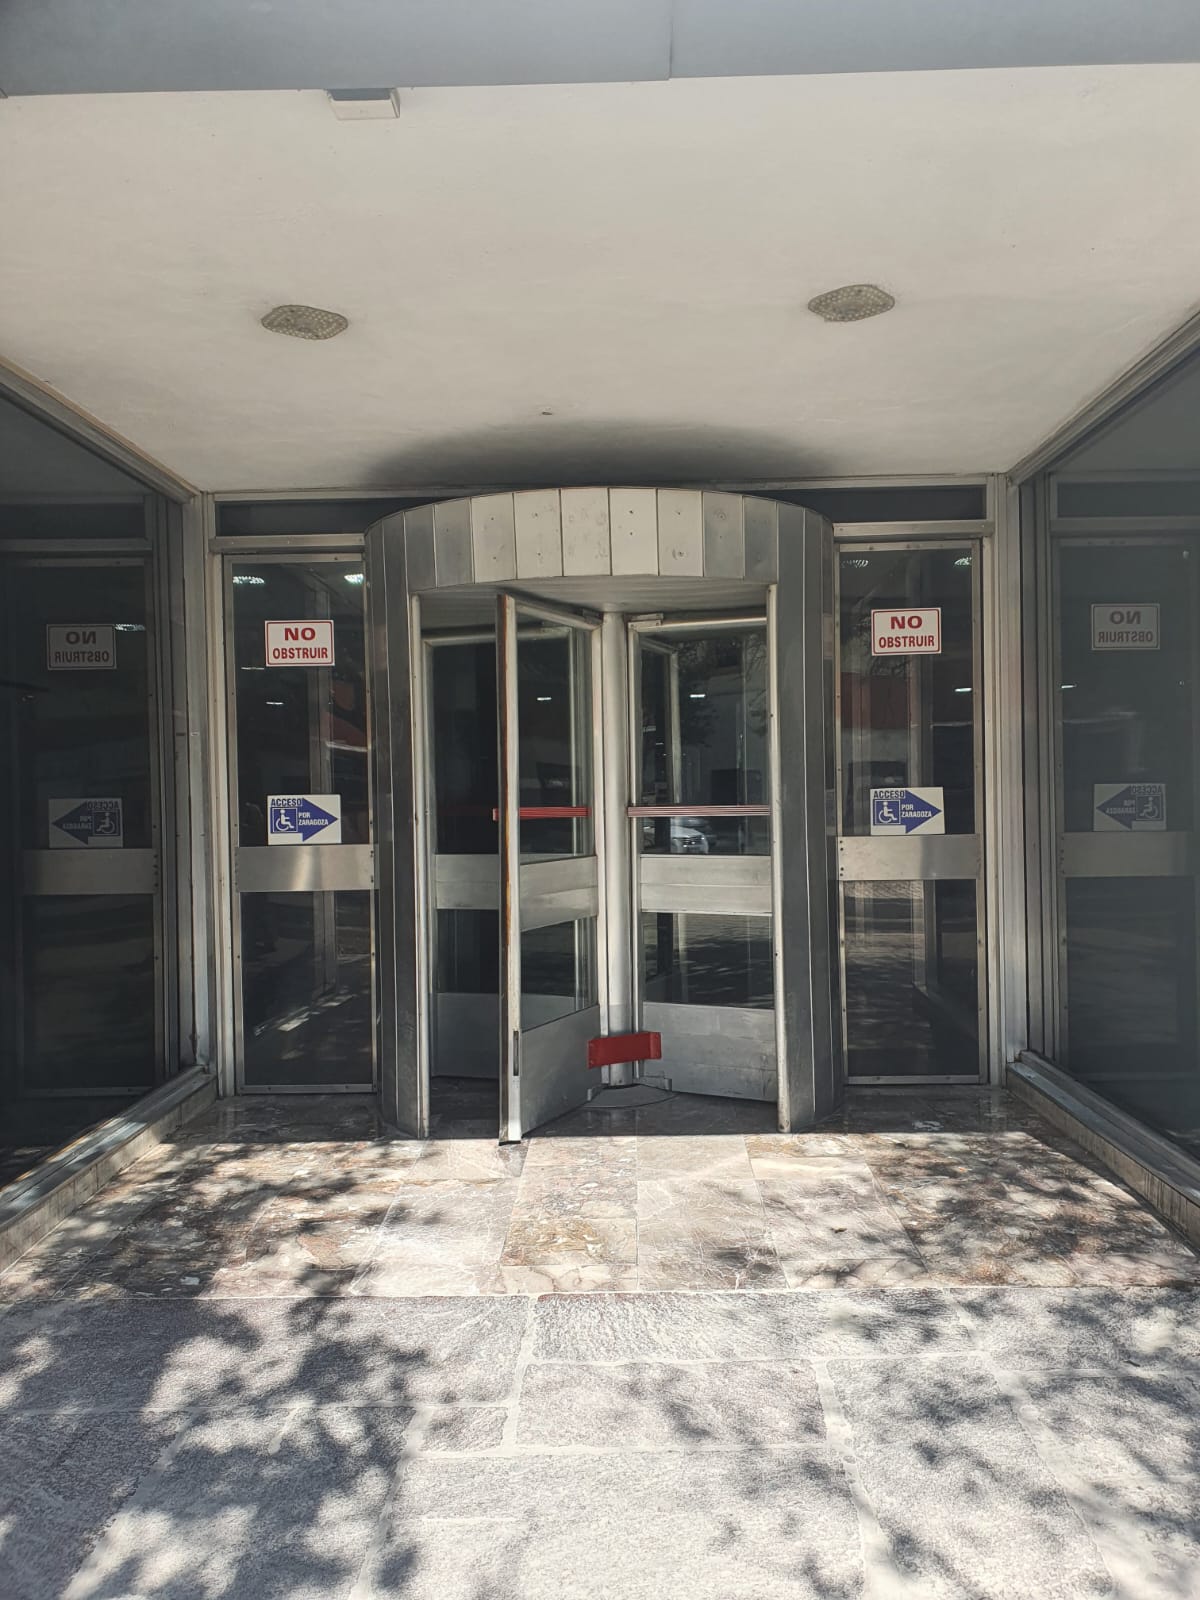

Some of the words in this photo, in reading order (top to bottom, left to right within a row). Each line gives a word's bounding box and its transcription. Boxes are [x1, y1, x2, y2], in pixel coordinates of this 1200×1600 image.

[891, 615, 923, 629] NO
[284, 628, 316, 641] NO
[879, 635, 935, 649] OBSTRUIR
[273, 647, 328, 660] OBSTRUIR
[873, 790, 906, 799] ACCESO
[270, 798, 303, 807] ACCESO
